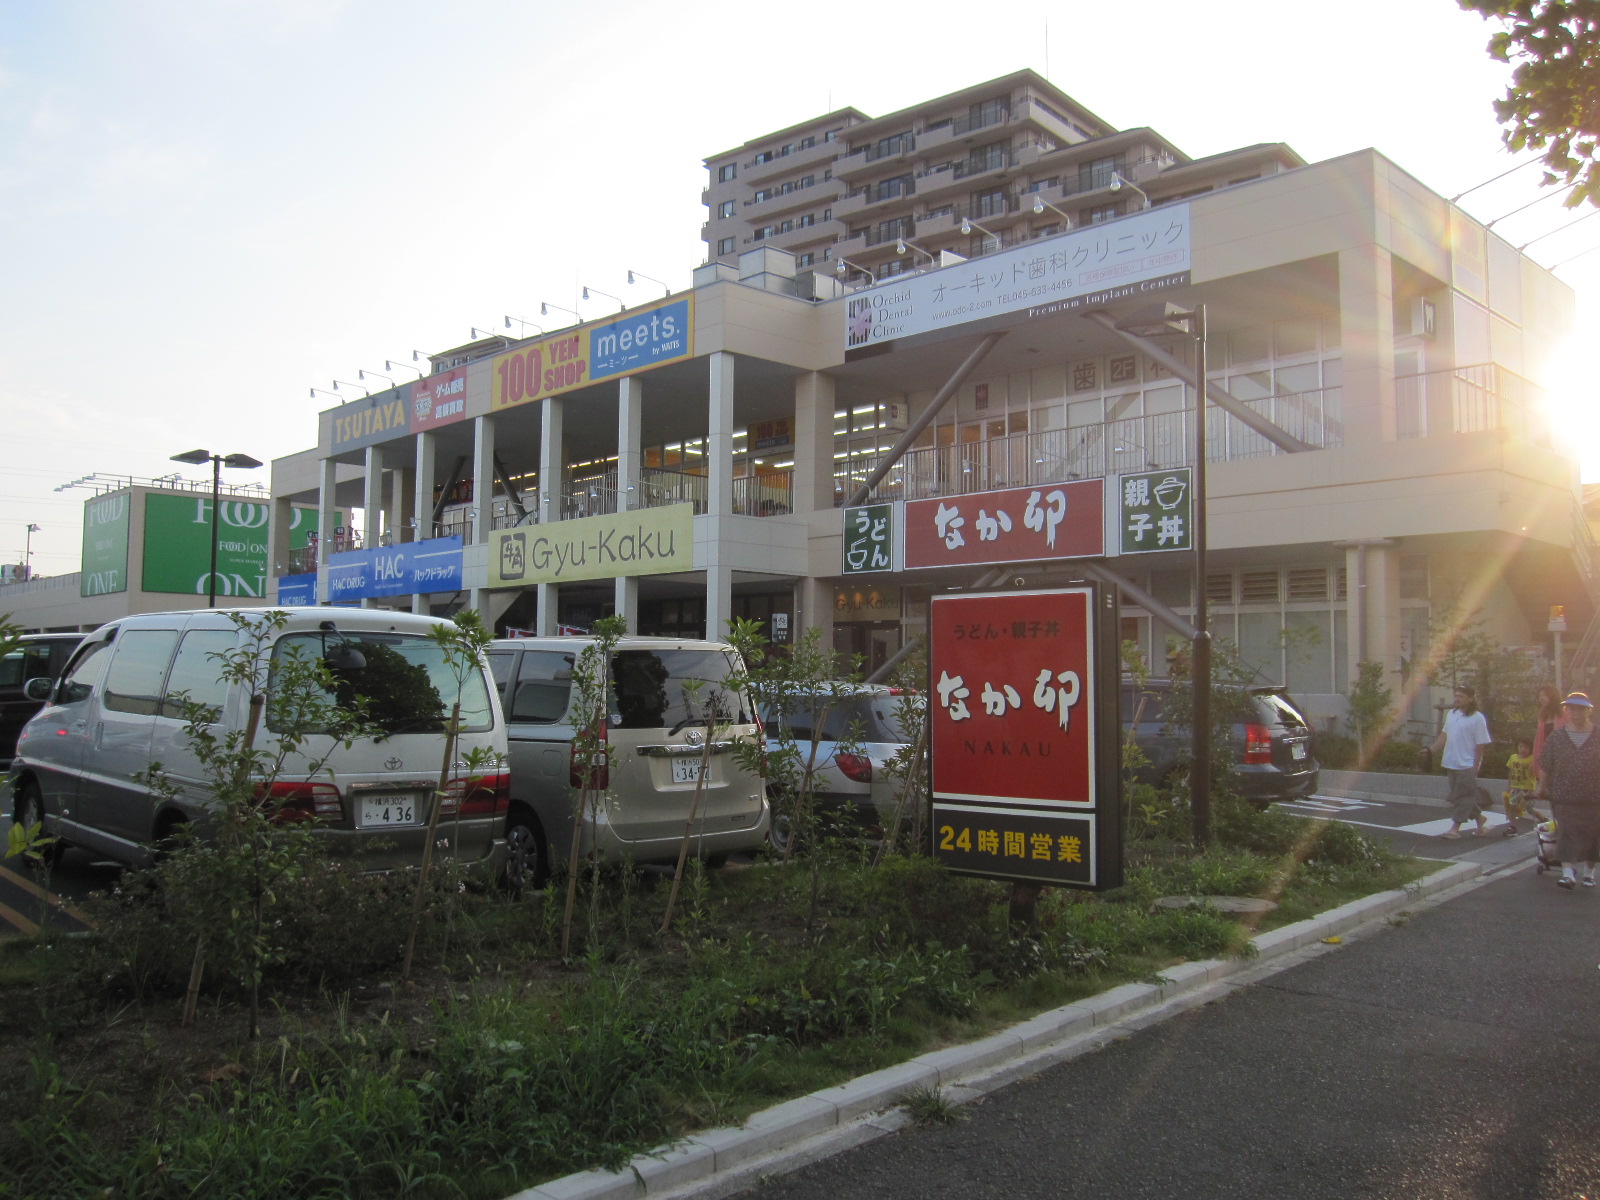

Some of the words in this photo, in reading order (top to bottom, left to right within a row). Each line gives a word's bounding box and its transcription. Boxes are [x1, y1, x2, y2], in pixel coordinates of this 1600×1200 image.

[932, 220, 1184, 304] オーキッド歯科クリニック
[872, 290, 912, 309] Orchid
[1028, 299, 1080, 318] Premium
[1086, 287, 1135, 304] Implant
[1140, 274, 1185, 292] Center
[878, 305, 914, 322] Dental
[932, 300, 992, 320] www.odc-2.com
[597, 315, 680, 358] meets.
[872, 323, 905, 339] Clinic
[661, 340, 680, 352] WATTS
[497, 347, 543, 405] 100
[548, 335, 580, 364] YEN
[544, 359, 587, 392] SHOP
[1112, 360, 1134, 380] 2F
[335, 400, 406, 444] TSUTAYA
[935, 489, 1068, 551] なか卯
[1124, 478, 1184, 546] 親子丼
[218, 540, 247, 553] FOOD
[532, 525, 676, 576] Gyu-Kaku
[855, 510, 889, 569] うどん
[375, 554, 404, 581] HAC
[503, 542, 523, 569] 牛角
[87, 570, 118, 597] ONE
[332, 578, 347, 591] HAC
[347, 575, 366, 589] DRUG
[413, 565, 456, 583] ハックドラッグ
[281, 597, 292, 607] HAC
[291, 595, 307, 606] DRUG
[954, 620, 1060, 640] うどん・親子丼
[936, 668, 1081, 734] なか卯
[964, 740, 1051, 757] NAKAU
[939, 825, 1082, 863] 24時間営業
